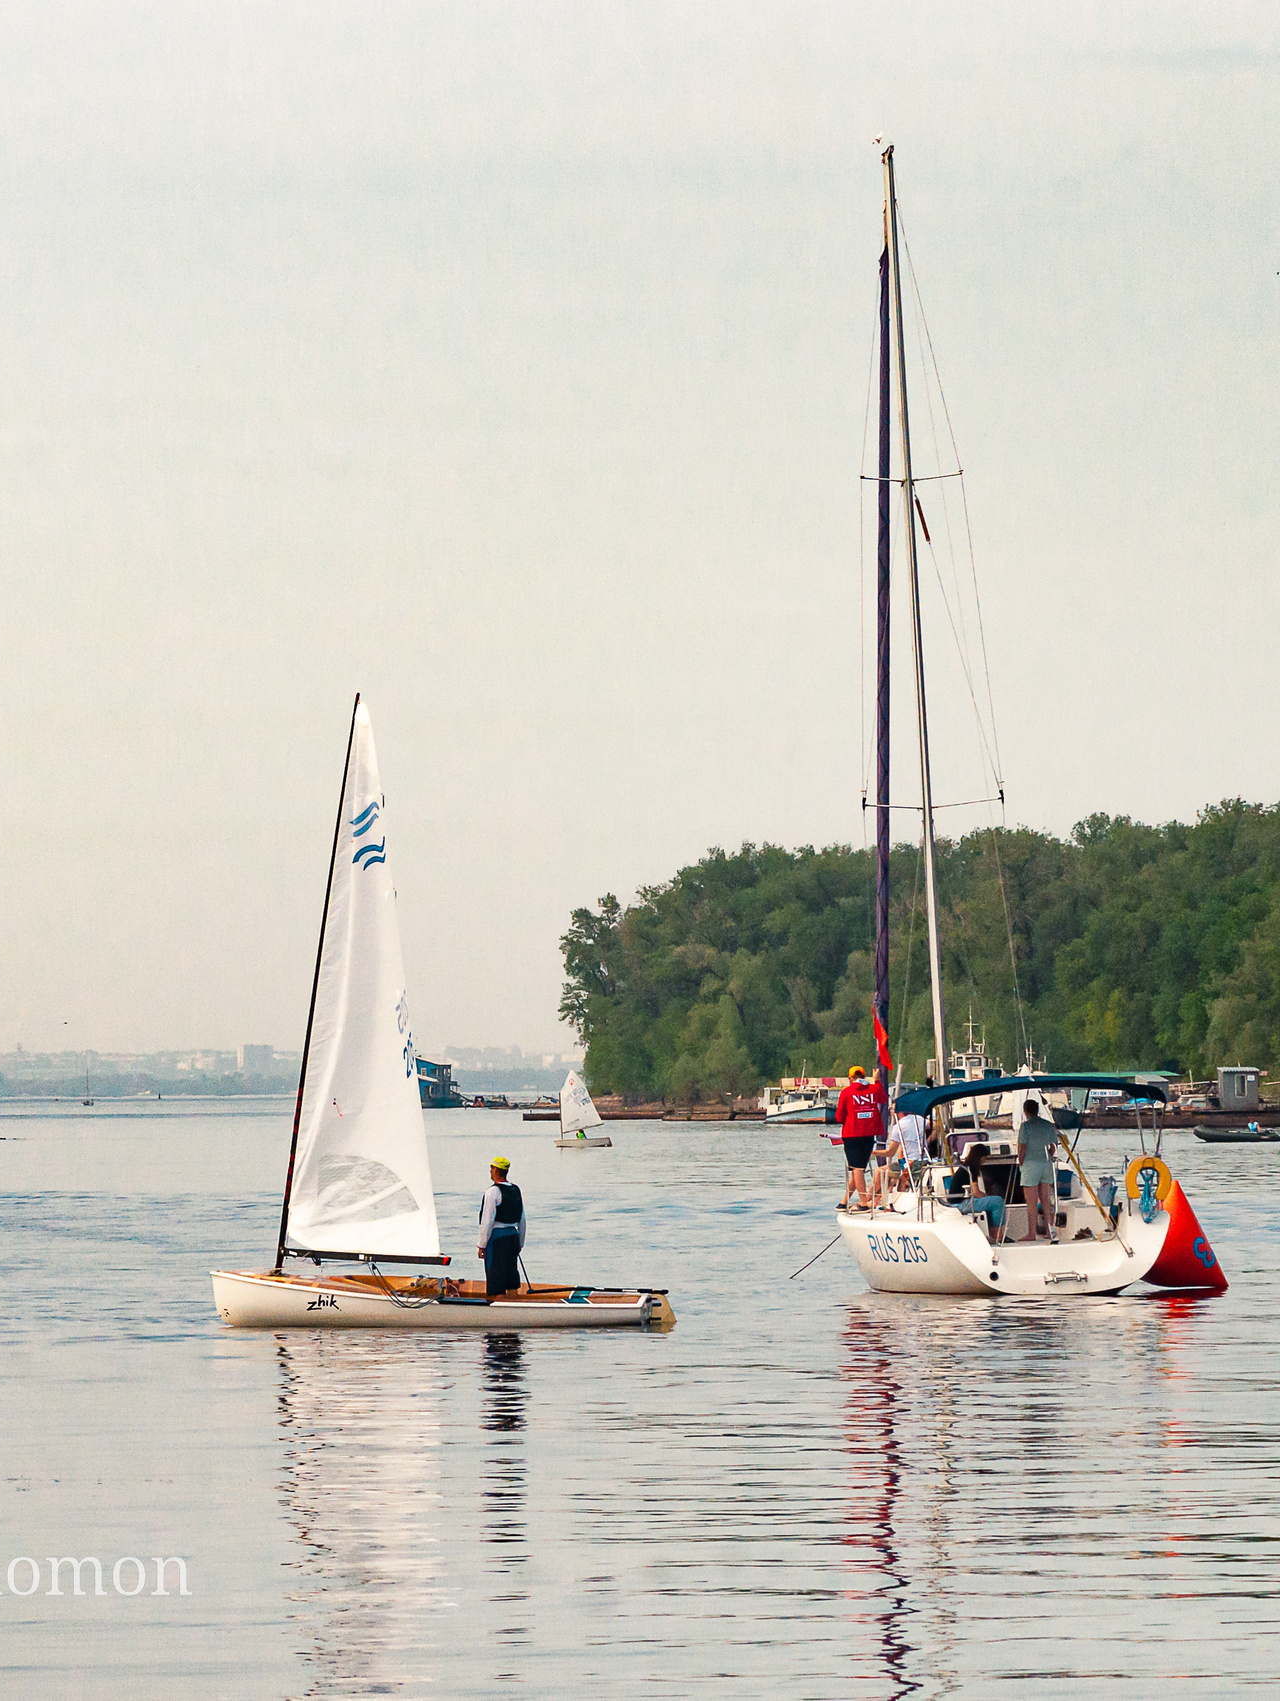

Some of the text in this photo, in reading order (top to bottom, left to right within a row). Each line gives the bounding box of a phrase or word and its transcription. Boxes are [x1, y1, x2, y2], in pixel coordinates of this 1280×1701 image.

[867, 1233, 928, 1263] RUS 205
[306, 1294, 341, 1311] zhik
